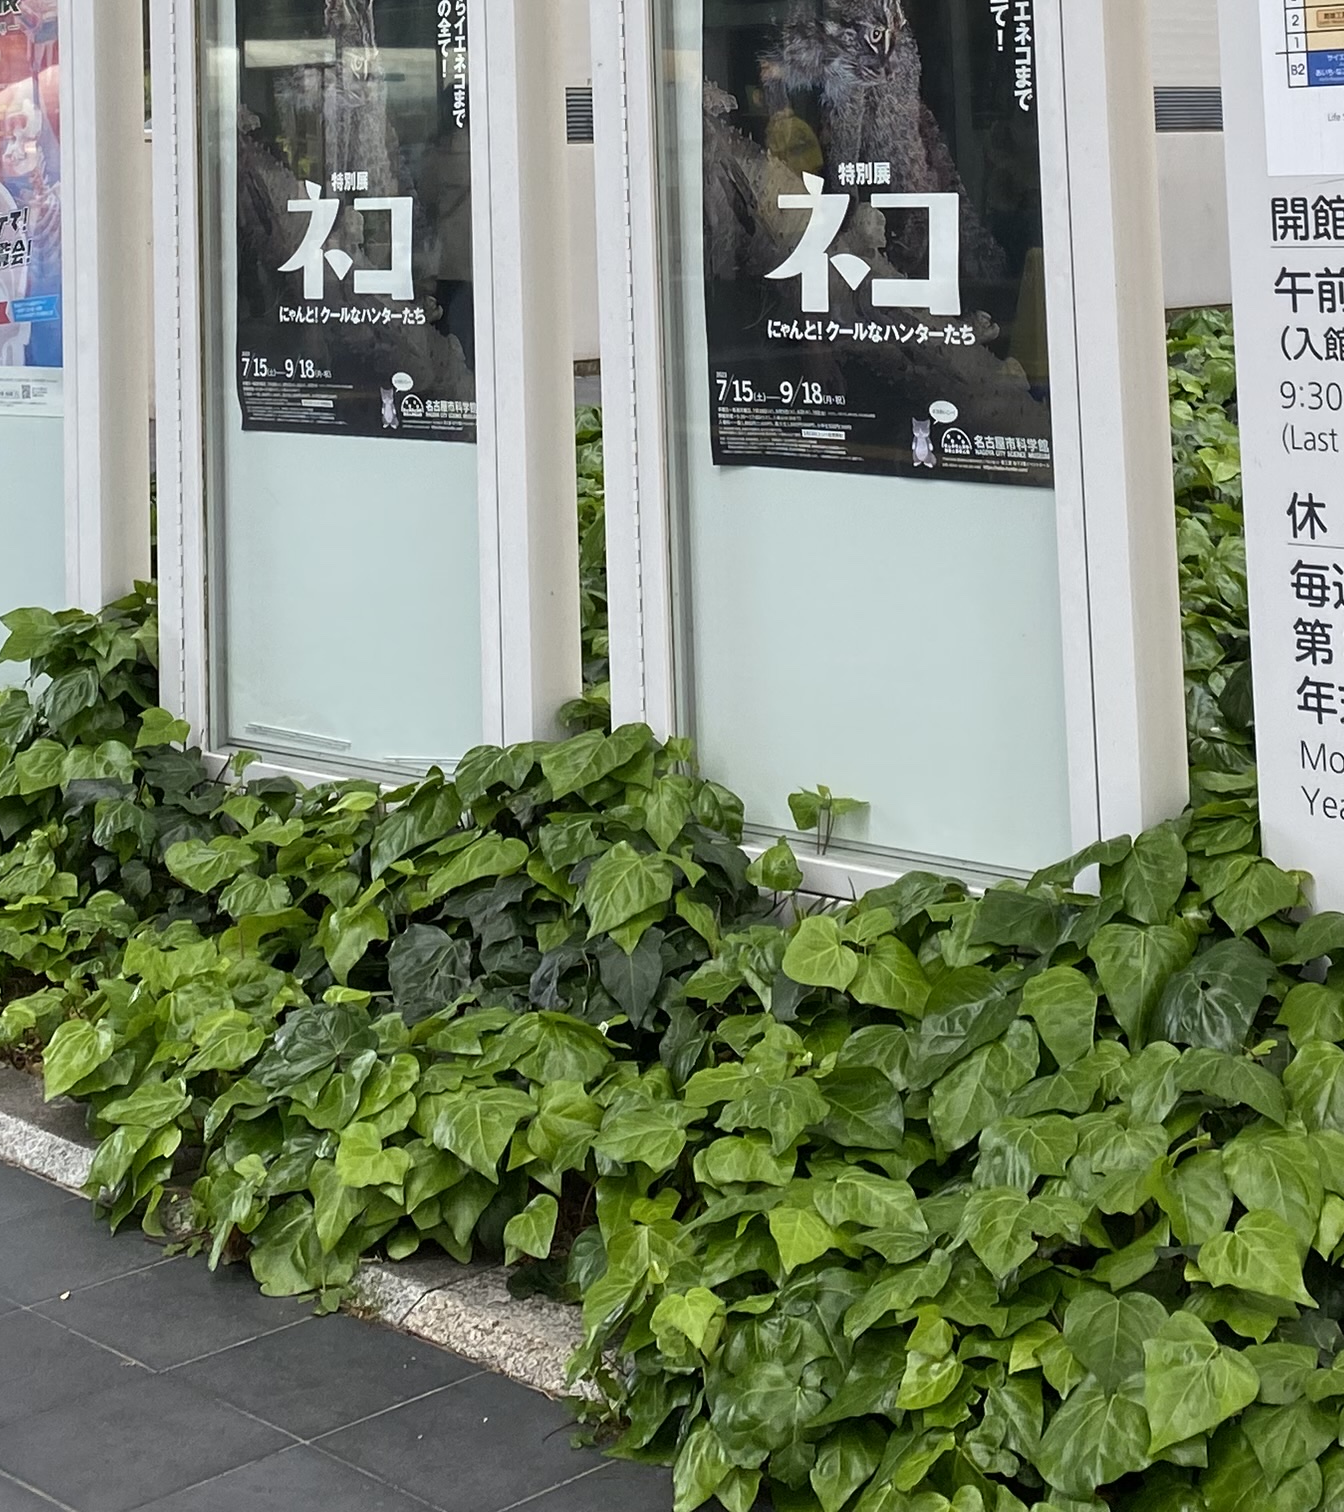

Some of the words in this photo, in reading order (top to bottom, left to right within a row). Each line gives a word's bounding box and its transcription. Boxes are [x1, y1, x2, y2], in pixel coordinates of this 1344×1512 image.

[1292, 14, 1300, 26] 2
[1294, 37, 1299, 48] 1
[1291, 64, 1305, 76] B2
[1327, 112, 1341, 122] Life
[331, 171, 369, 191] 特別展
[838, 162, 891, 185] 特別展
[277, 179, 415, 301] ネコ
[764, 171, 962, 317] ネコ
[279, 306, 319, 324] にゃんと!
[322, 307, 426, 325] クールなハンターたち
[767, 320, 823, 341] にゃんと!
[827, 321, 976, 346] クールなハンターたち
[1279, 381, 1344, 412] 9:30
[974, 435, 1049, 452] 名古屋市科学館
[1281, 423, 1340, 456] (Last
